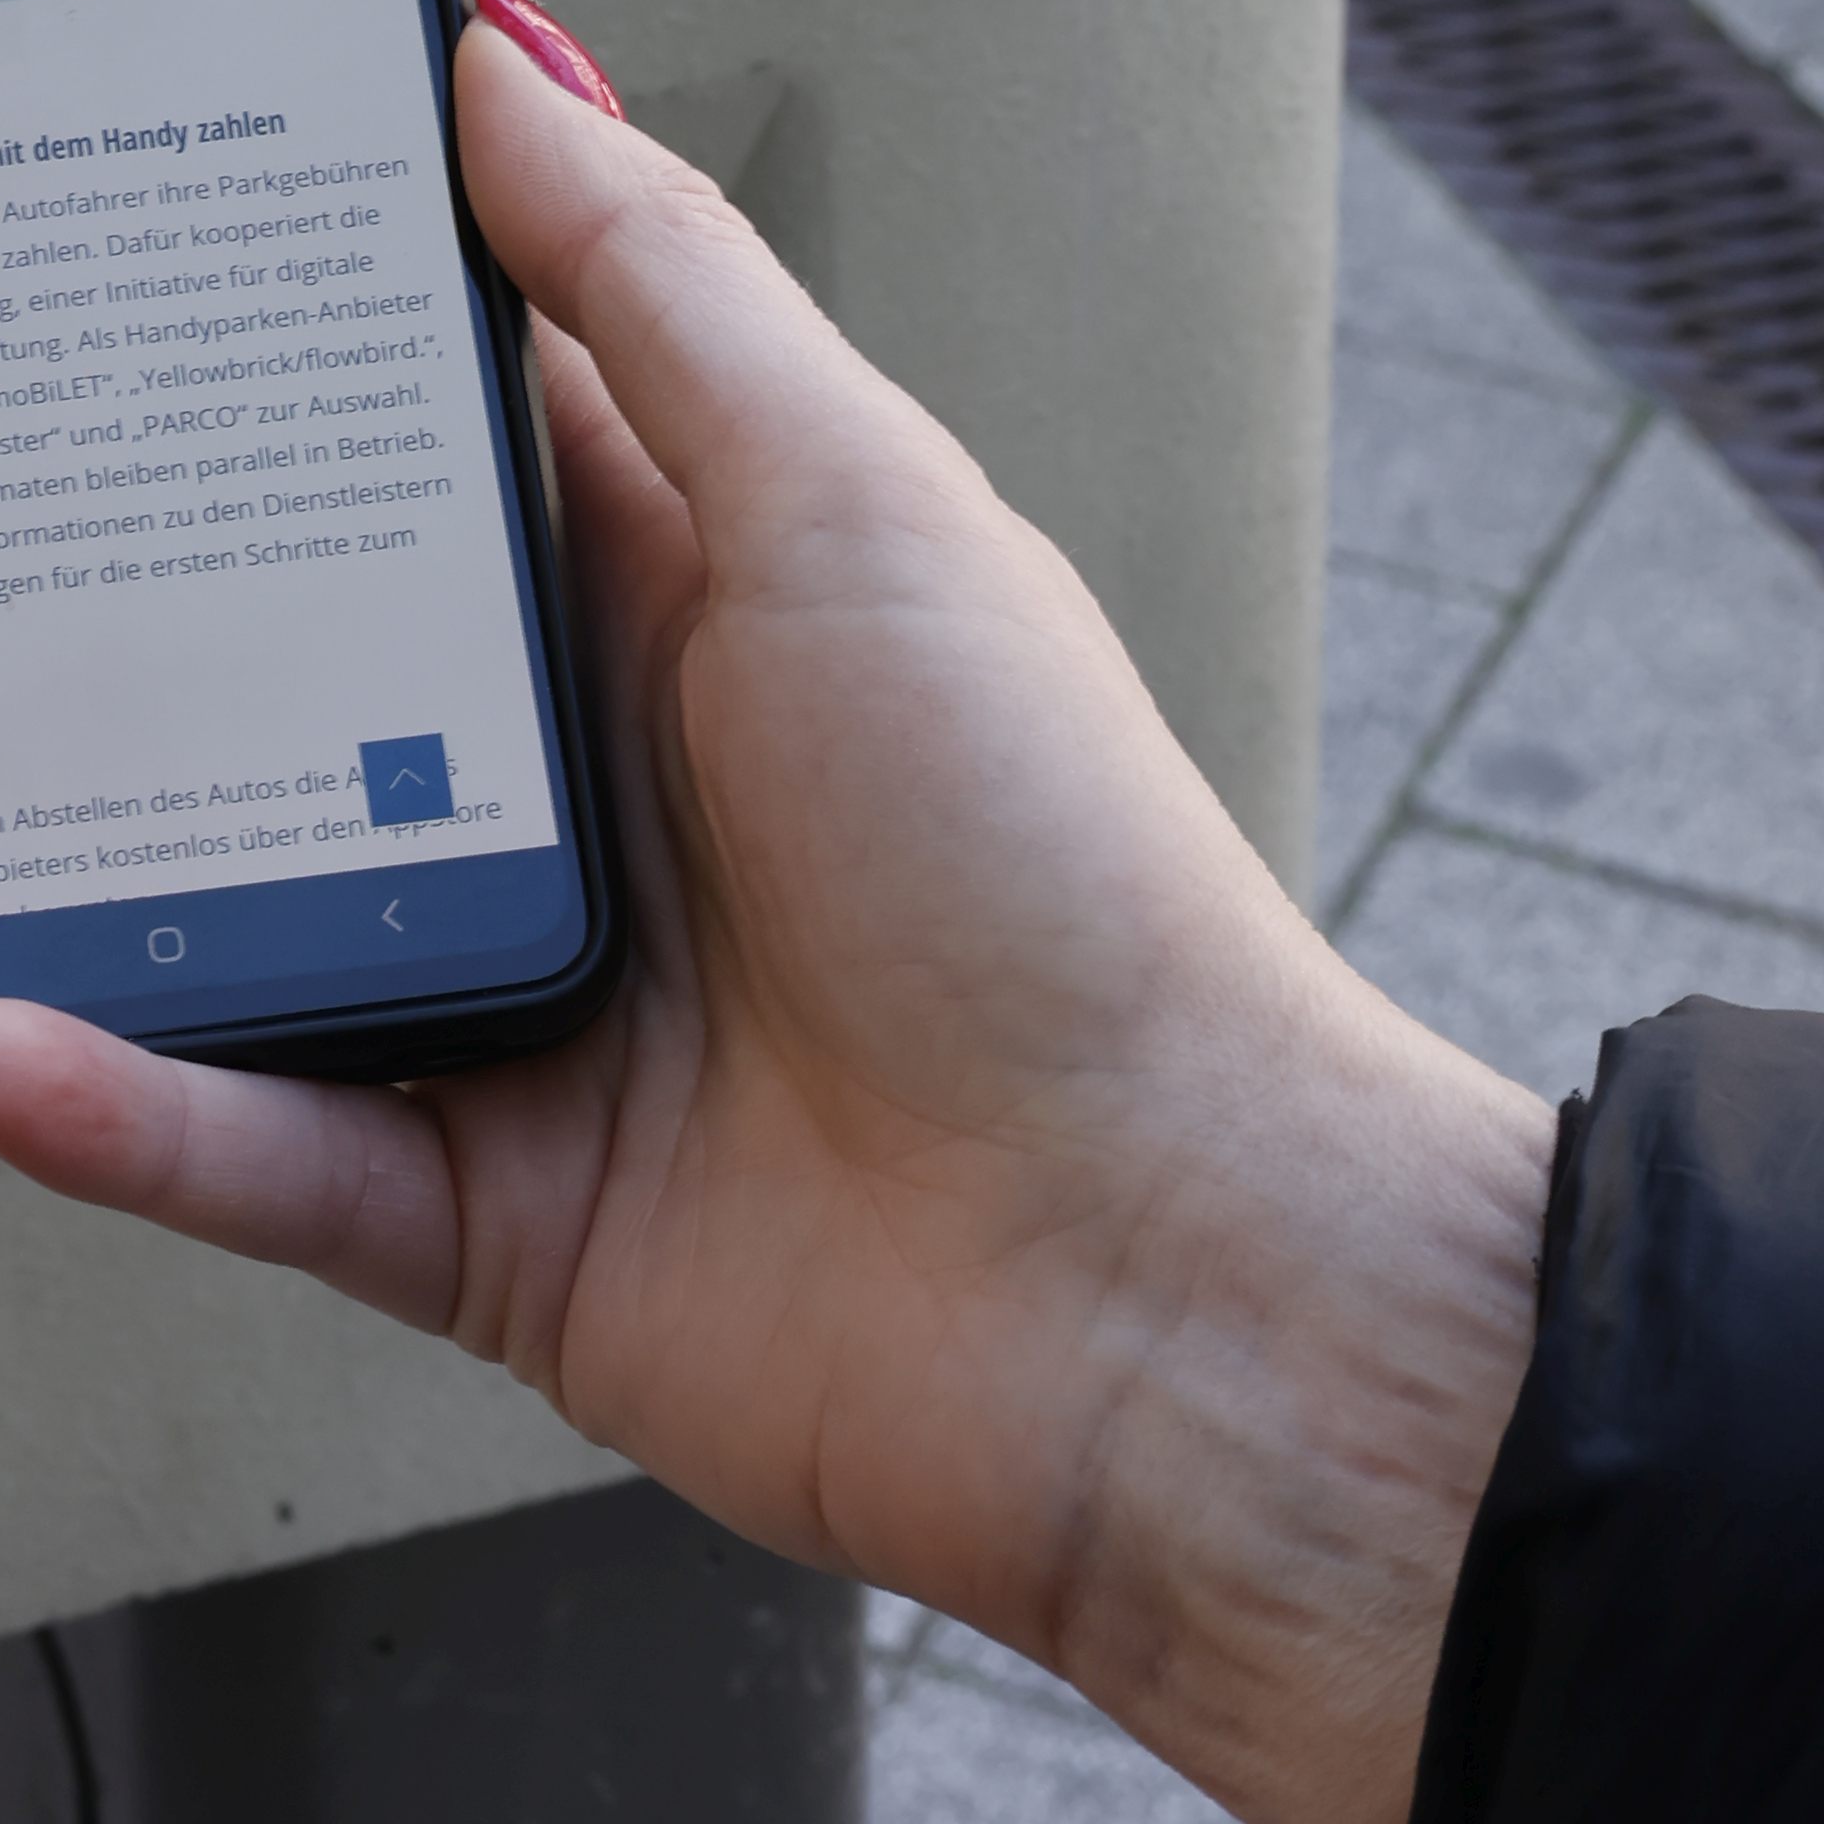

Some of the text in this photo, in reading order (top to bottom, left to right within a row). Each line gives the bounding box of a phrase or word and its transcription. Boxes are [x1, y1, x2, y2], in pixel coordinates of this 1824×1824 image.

[31, 133, 94, 162] dem
[100, 119, 188, 154] Handy
[195, 109, 287, 143] zahlen
[1, 188, 150, 224] Autofahrer
[155, 180, 211, 205] ihre
[216, 158, 409, 198] Parkgebühren
[0, 240, 99, 270] zahlen.
[105, 227, 183, 257] Dafür
[188, 210, 334, 248] kooperiert
[338, 204, 381, 229] die
[27, 286, 99, 312] einer
[104, 271, 222, 303] Initiative
[226, 263, 268, 289] für
[275, 250, 375, 287] digitale
[76, 326, 118, 352] Als
[123, 291, 433, 346] Handyparken-Anbieter
[68, 417, 124, 447] und
[255, 401, 301, 424] zur
[306, 380, 430, 418] Auswahl.
[83, 461, 188, 491] bleiben
[194, 442, 297, 485] parallel
[302, 441, 330, 465] in
[336, 426, 445, 461] Betrieb.
[161, 508, 195, 529] zu
[201, 498, 256, 524] den
[261, 476, 453, 518] Dienstleistern
[49, 564, 92, 590] für
[98, 558, 142, 584] die
[148, 550, 238, 578] ersten
[243, 535, 351, 568] Schritte
[356, 528, 417, 554] zum
[11, 795, 143, 832] Abstellen
[149, 787, 201, 814] des
[206, 778, 288, 807] Autos
[294, 769, 339, 795] die
[94, 832, 232, 869] kostenlos
[237, 824, 304, 852] über
[311, 816, 366, 842] den
